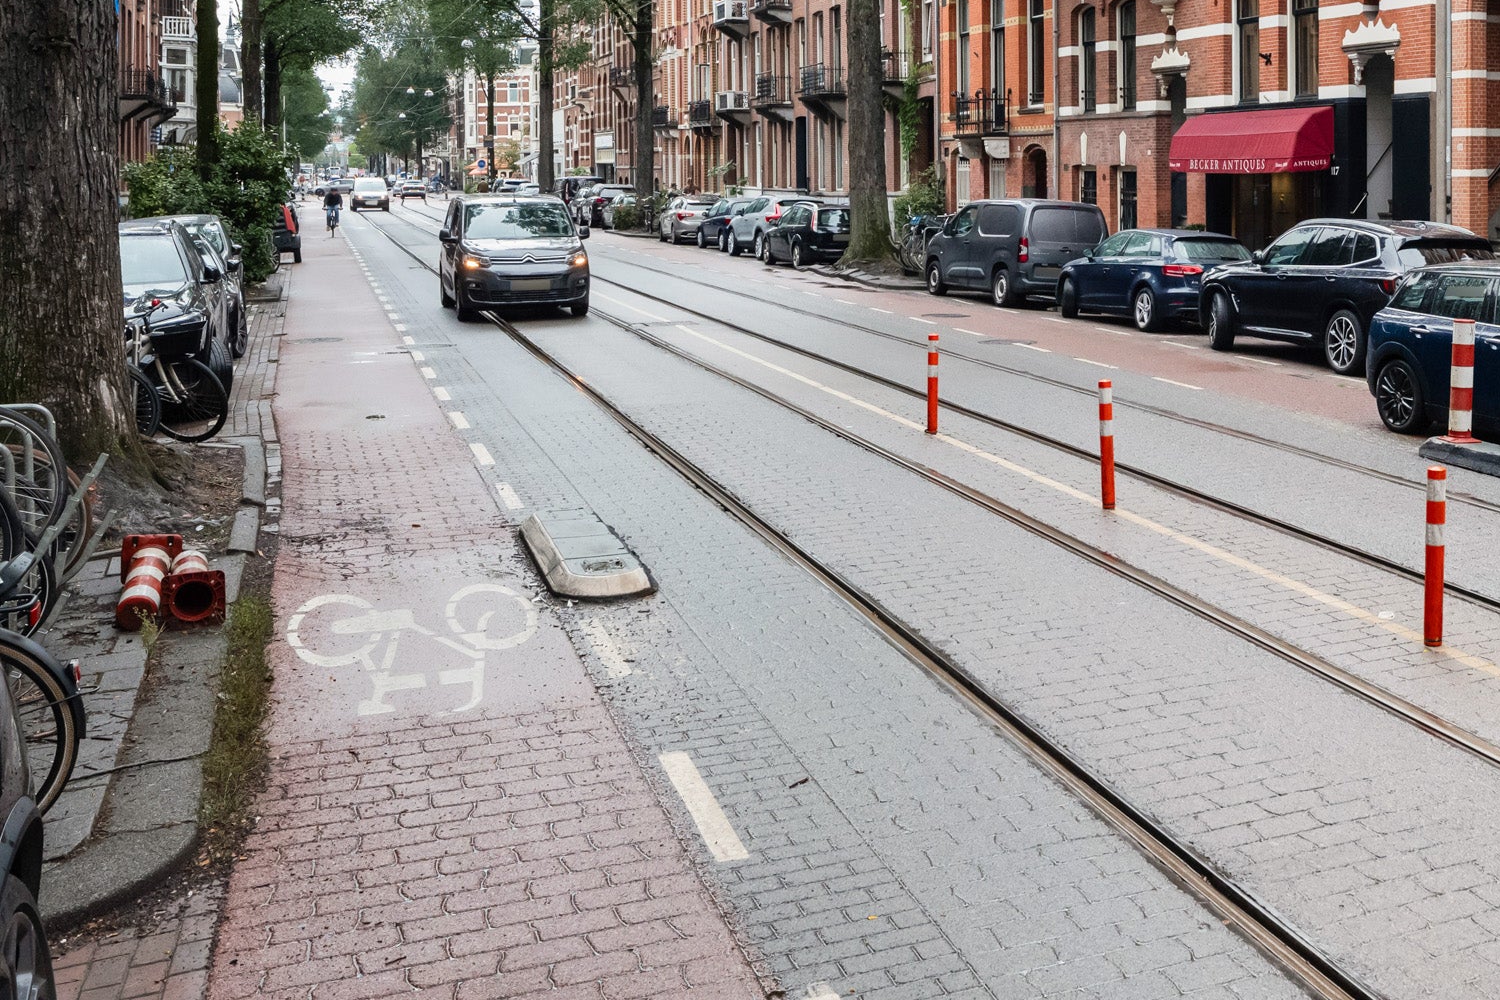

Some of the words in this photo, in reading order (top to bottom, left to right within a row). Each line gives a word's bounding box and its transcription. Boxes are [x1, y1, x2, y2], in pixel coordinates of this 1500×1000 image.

[1189, 158, 1220, 170] BECKER
[1222, 158, 1266, 173] ANTIQUES
[1293, 159, 1327, 168] ANTIQUES
[1331, 166, 1340, 176] 117
